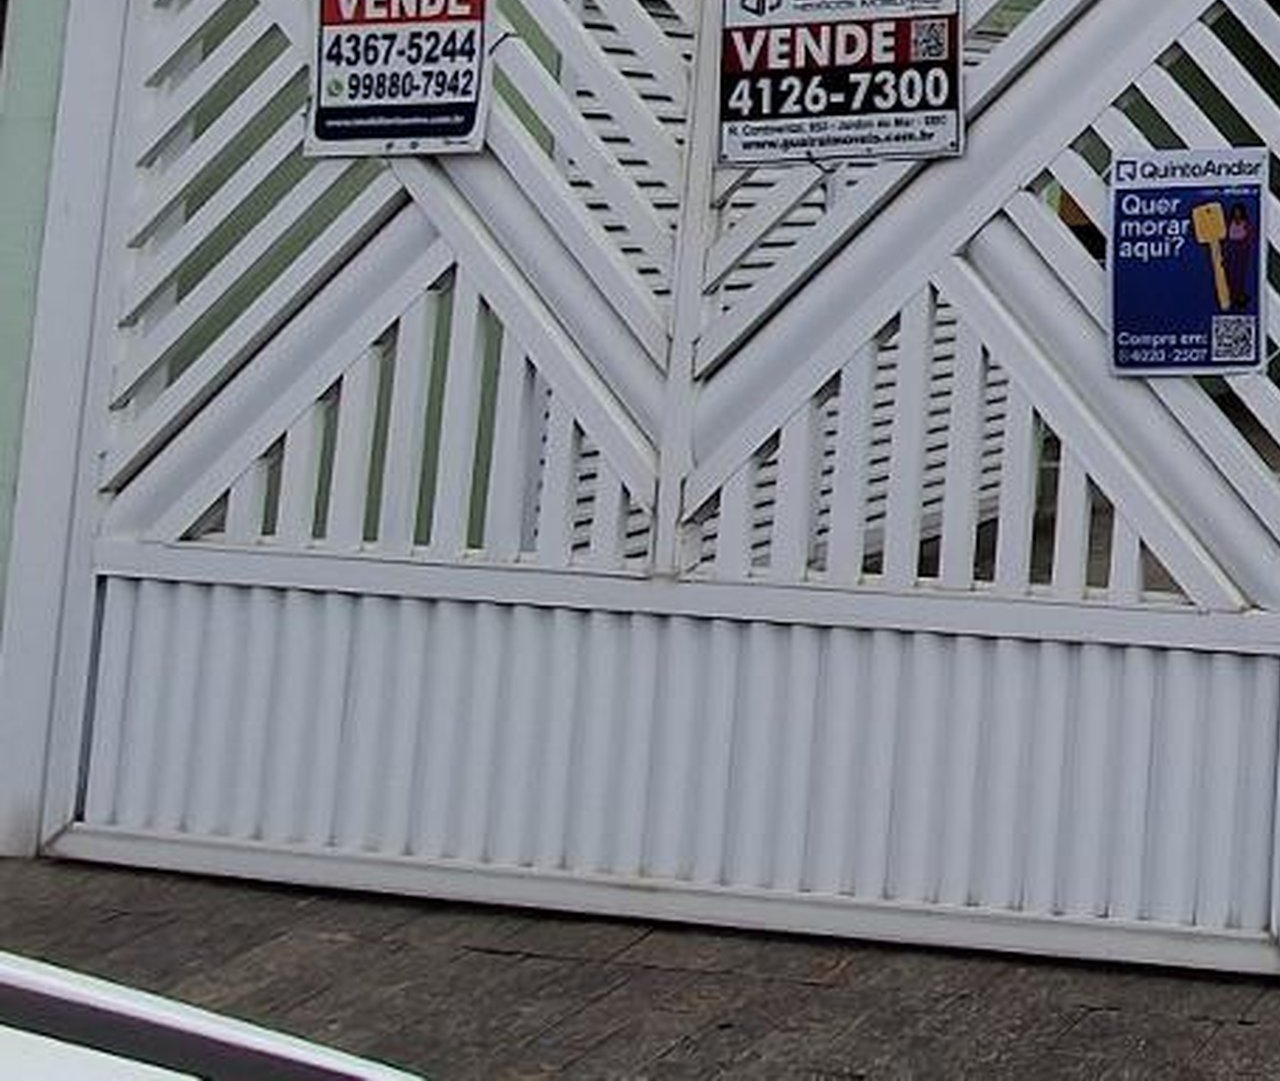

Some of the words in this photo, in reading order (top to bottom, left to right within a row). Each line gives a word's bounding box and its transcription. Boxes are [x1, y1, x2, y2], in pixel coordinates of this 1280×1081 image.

[326, 29, 476, 66] 4367-5244
[731, 22, 896, 71] VENDE
[348, 70, 474, 100] 99880-7942
[728, 68, 949, 116] 4126-7300
[1140, 160, 1262, 180] QuintoAndar
[1121, 194, 1181, 215] Quer
[1121, 219, 1191, 237] morar
[1119, 236, 1185, 263] aqui?
